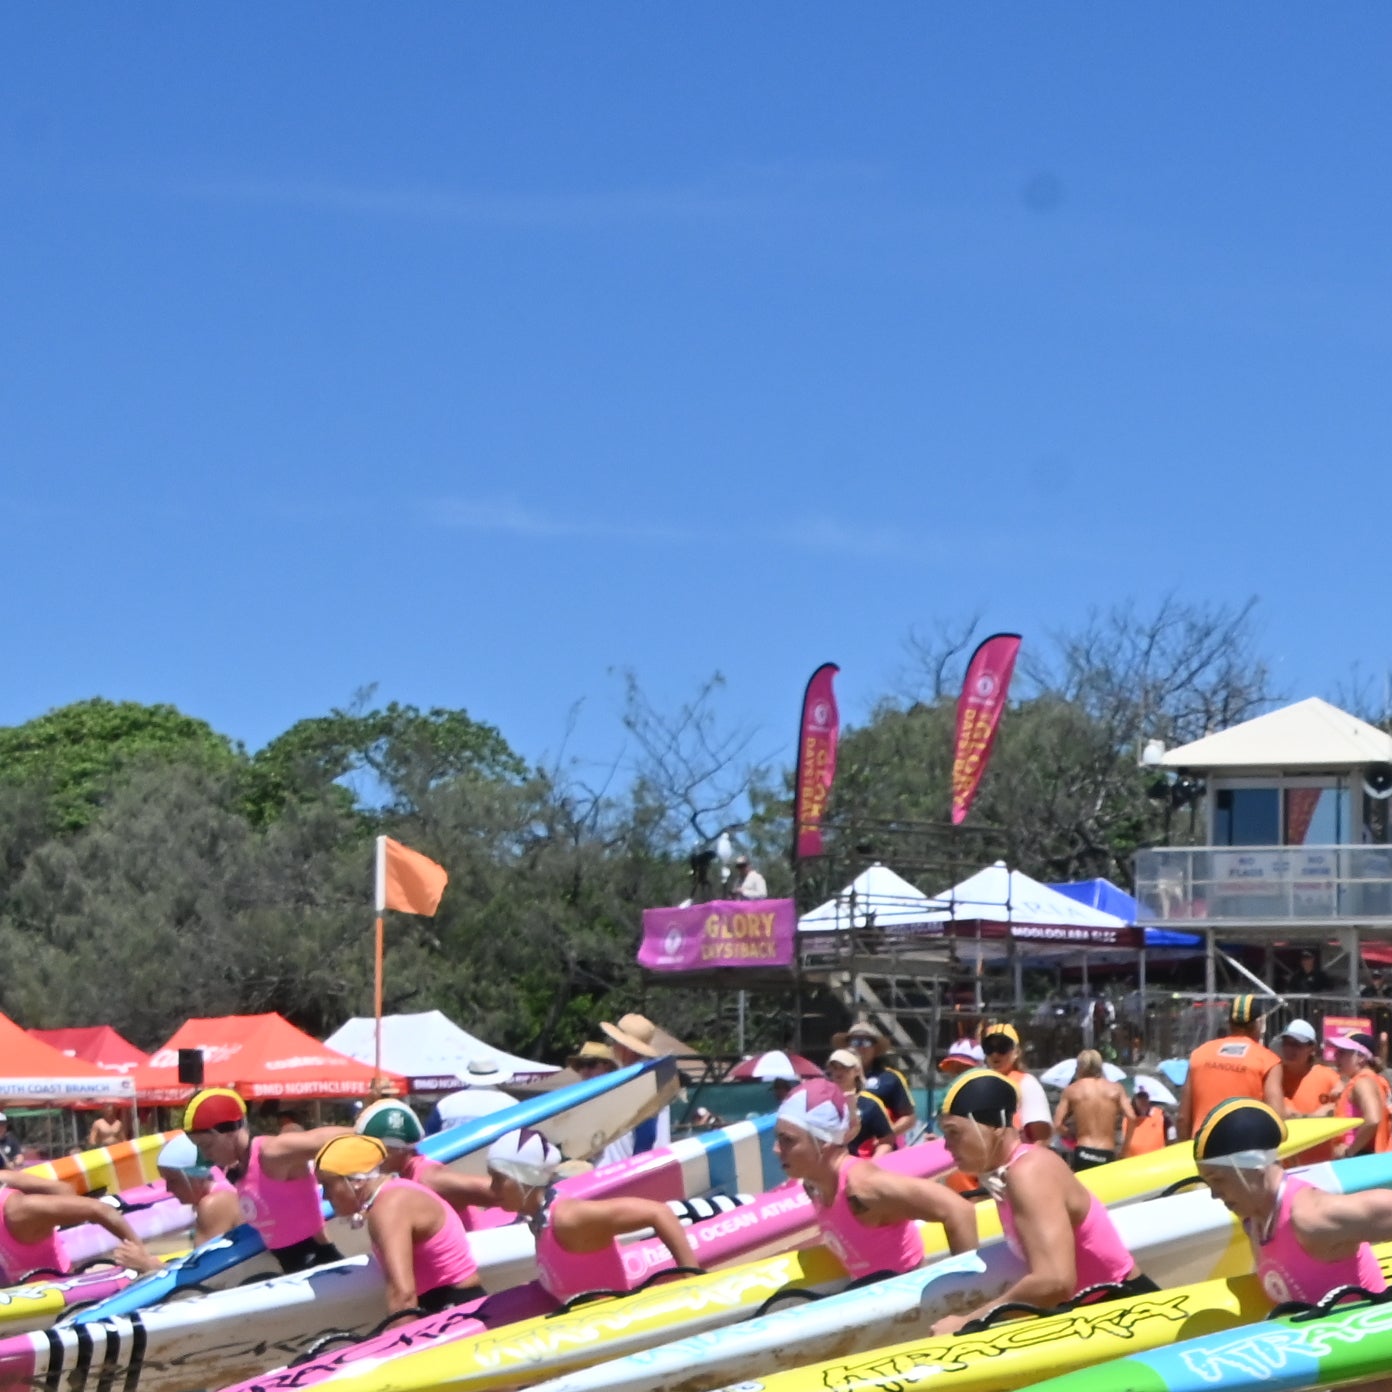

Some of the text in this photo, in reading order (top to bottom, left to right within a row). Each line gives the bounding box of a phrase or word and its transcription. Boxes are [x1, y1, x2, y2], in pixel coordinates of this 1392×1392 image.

[704, 912, 777, 939] GLORY
[28, 1084, 64, 1094] COAST
[66, 1083, 110, 1094] BRANCH
[253, 1081, 284, 1097] BMD
[286, 1080, 365, 1095] NORTHCLIFFE
[700, 1211, 759, 1243] OCEAN
